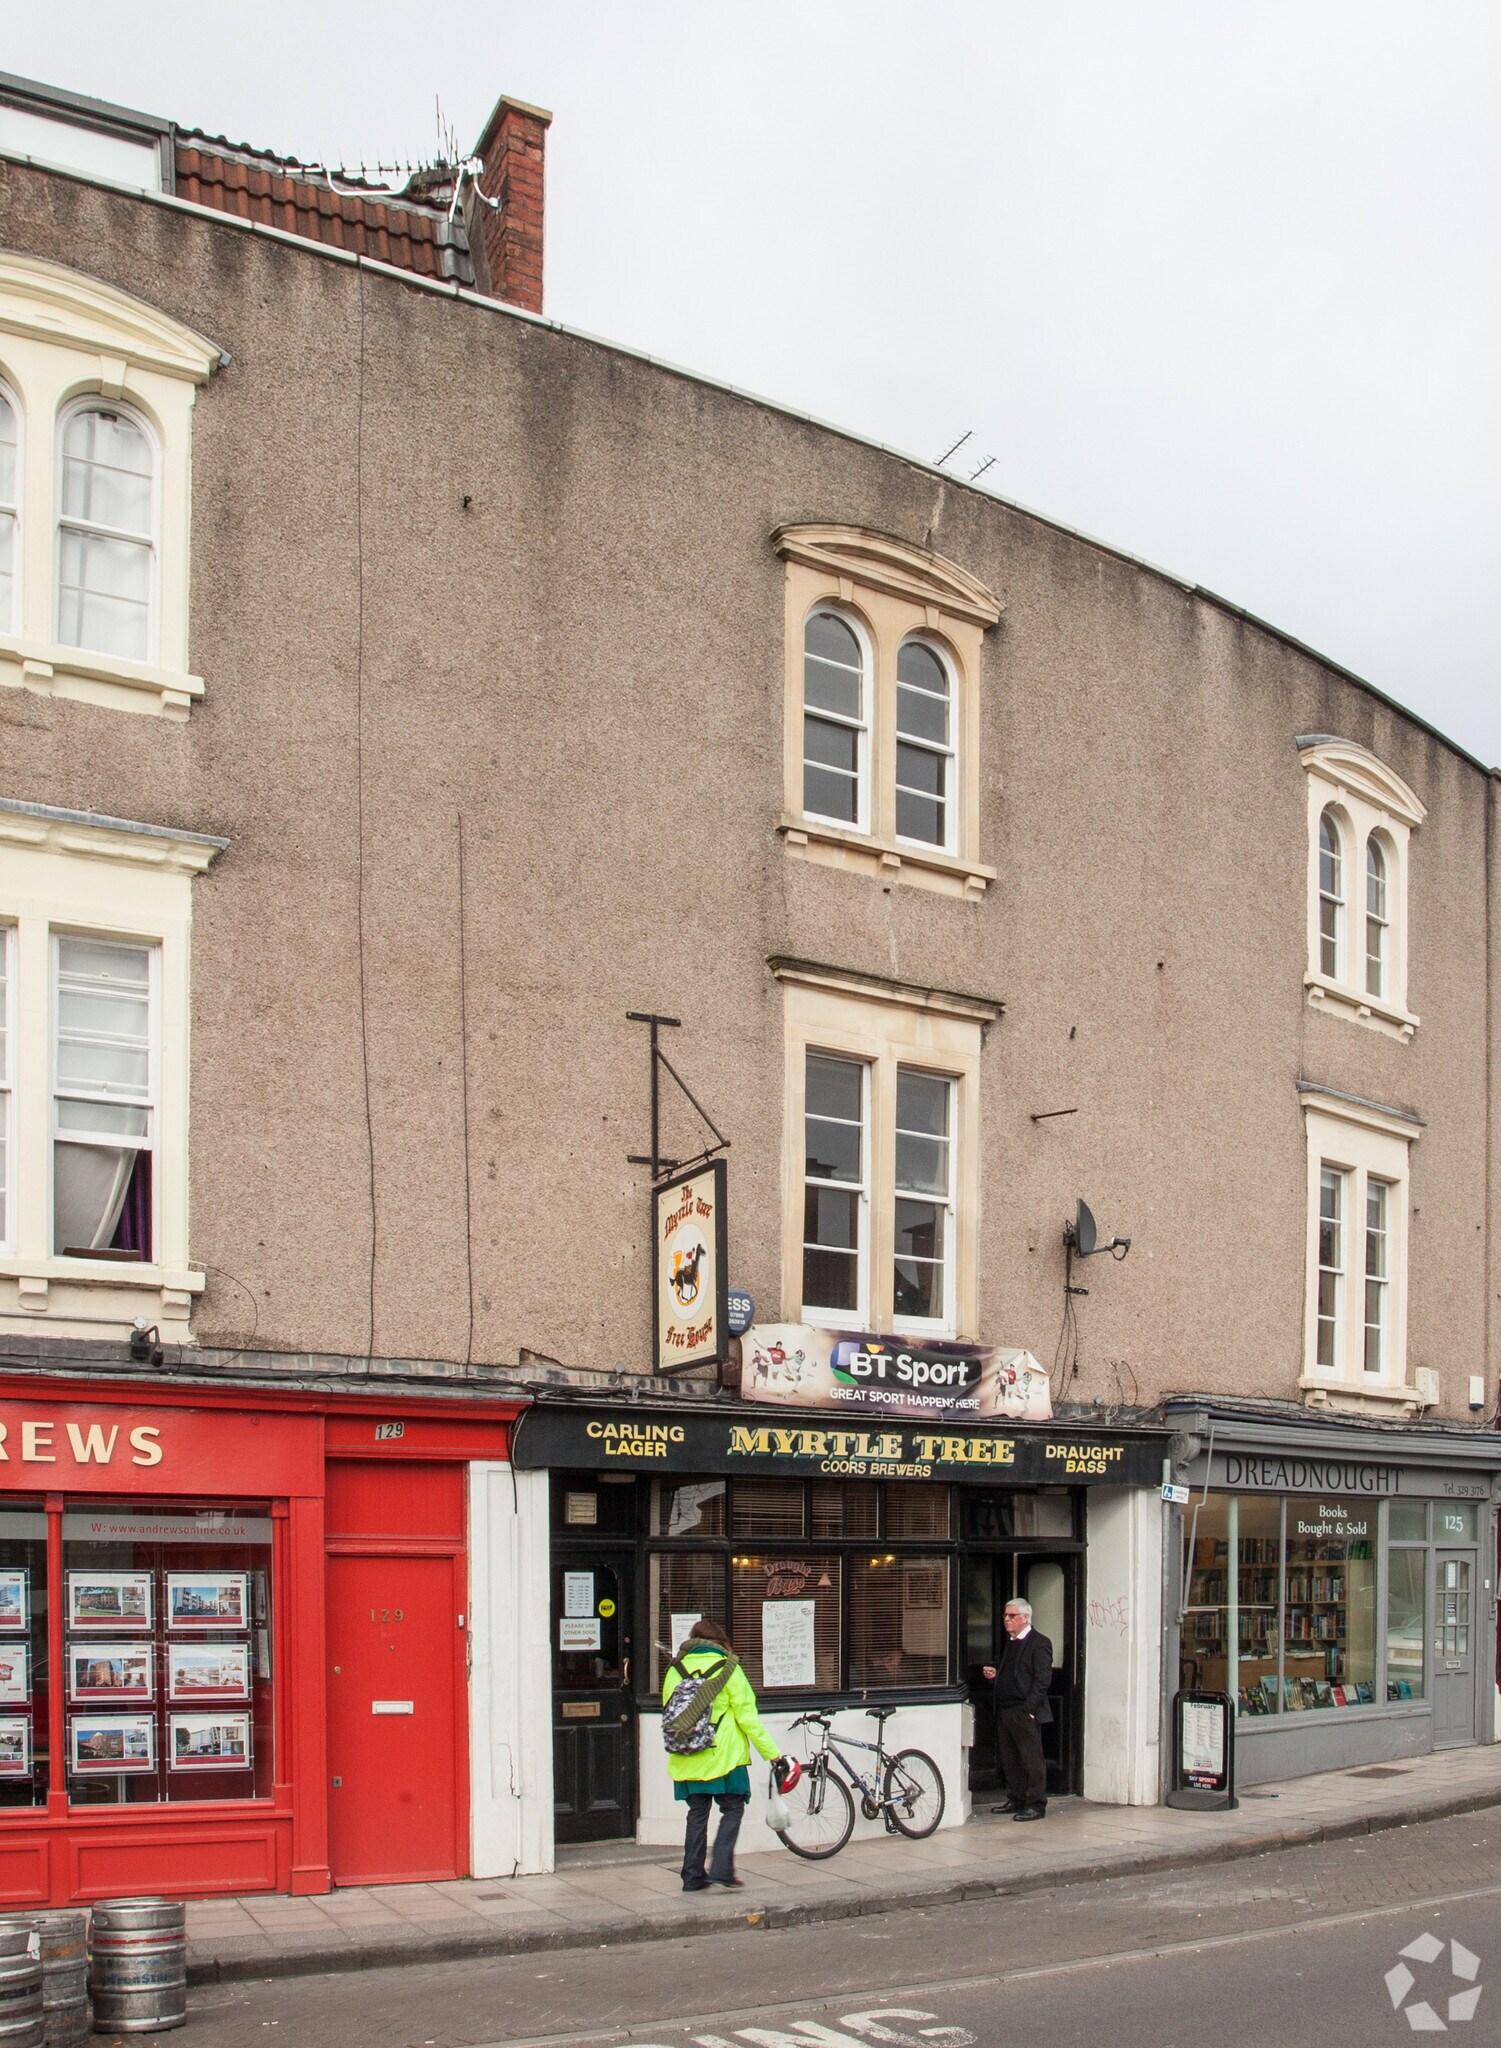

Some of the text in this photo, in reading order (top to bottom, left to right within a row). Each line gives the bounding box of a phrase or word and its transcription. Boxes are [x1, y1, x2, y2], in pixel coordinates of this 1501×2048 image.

[850, 1352, 969, 1387] BT Sport
[829, 1387, 980, 1410] GREAT SPORT HAPPENS HERE
[377, 1422, 403, 1440] 129
[586, 1421, 685, 1443] CARLING
[605, 1439, 667, 1458] LAGER
[727, 1426, 1016, 1468] MYRTLE TREE
[1046, 1444, 1124, 1461] DRAUGHT
[821, 1459, 932, 1478] COORS BREWERS
[1065, 1460, 1107, 1475] BASS
[1226, 1456, 1405, 1492] DREADNOUGHT
[1457, 1485, 1469, 1496] 329
[1470, 1486, 1485, 1497] 3176
[1319, 1504, 1348, 1519] Books
[91, 1522, 247, 1536] W: www.andrewsonline.co.uk
[1298, 1521, 1367, 1538] Bought & Sold
[1445, 1515, 1463, 1533] 125
[370, 1608, 404, 1623] 129
[1191, 1703, 1217, 1711] February
